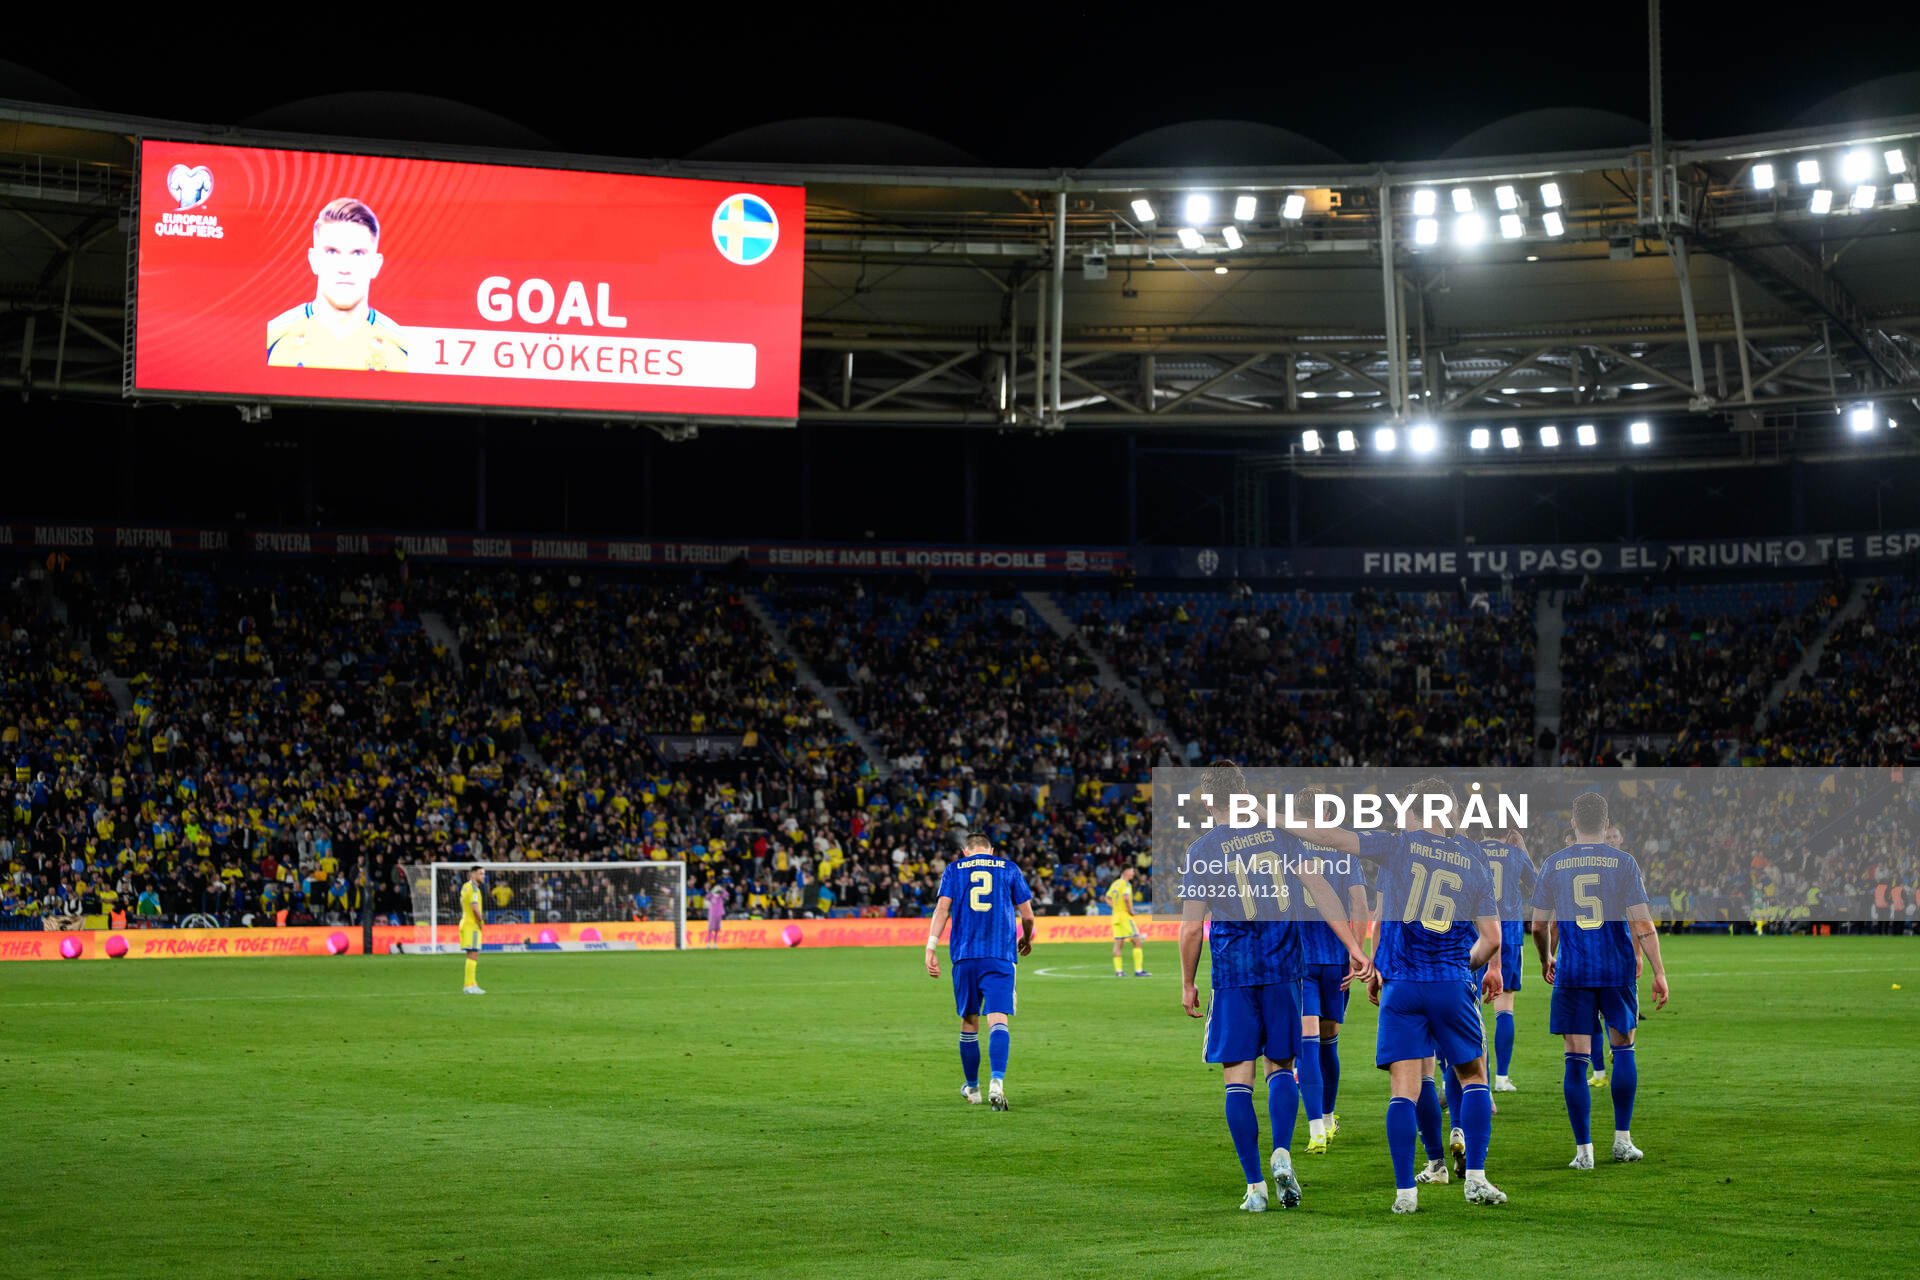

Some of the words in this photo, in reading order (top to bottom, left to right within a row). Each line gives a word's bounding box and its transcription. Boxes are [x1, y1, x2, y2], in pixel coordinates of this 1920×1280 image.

[155, 222, 224, 239] QUALIFIERS
[162, 213, 217, 226] EUROPEAN
[476, 275, 627, 328] GOAL
[433, 339, 476, 367] 17
[493, 335, 684, 377] GYÖKERES
[34, 526, 94, 546] MANISES
[115, 527, 172, 548] PATERNA
[472, 537, 512, 557] SUECA
[1364, 552, 1457, 573] FIRME
[1467, 551, 1507, 573] TU
[1519, 550, 1602, 572] PASO
[1620, 547, 1657, 568] EL
[1668, 540, 1807, 567] TRIUNFO
[1816, 537, 1854, 560] TE
[768, 548, 834, 565] SEMPRE
[839, 549, 877, 566] AMB
[880, 549, 902, 566] EL
[906, 550, 975, 567] NOSTRE
[980, 552, 1046, 569] POBLE
[1220, 830, 1276, 854] GYÖKERES
[1410, 842, 1471, 870] KARLSTRÖM
[1555, 856, 1619, 870] GUDMUNDSSON
[970, 870, 993, 912] 2
[1403, 861, 1463, 935] 16
[1573, 873, 1604, 930] 5
[144, 938, 228, 955] STRONGER
[234, 936, 310, 953] TOGETHER
[617, 930, 693, 946] STRONGR
